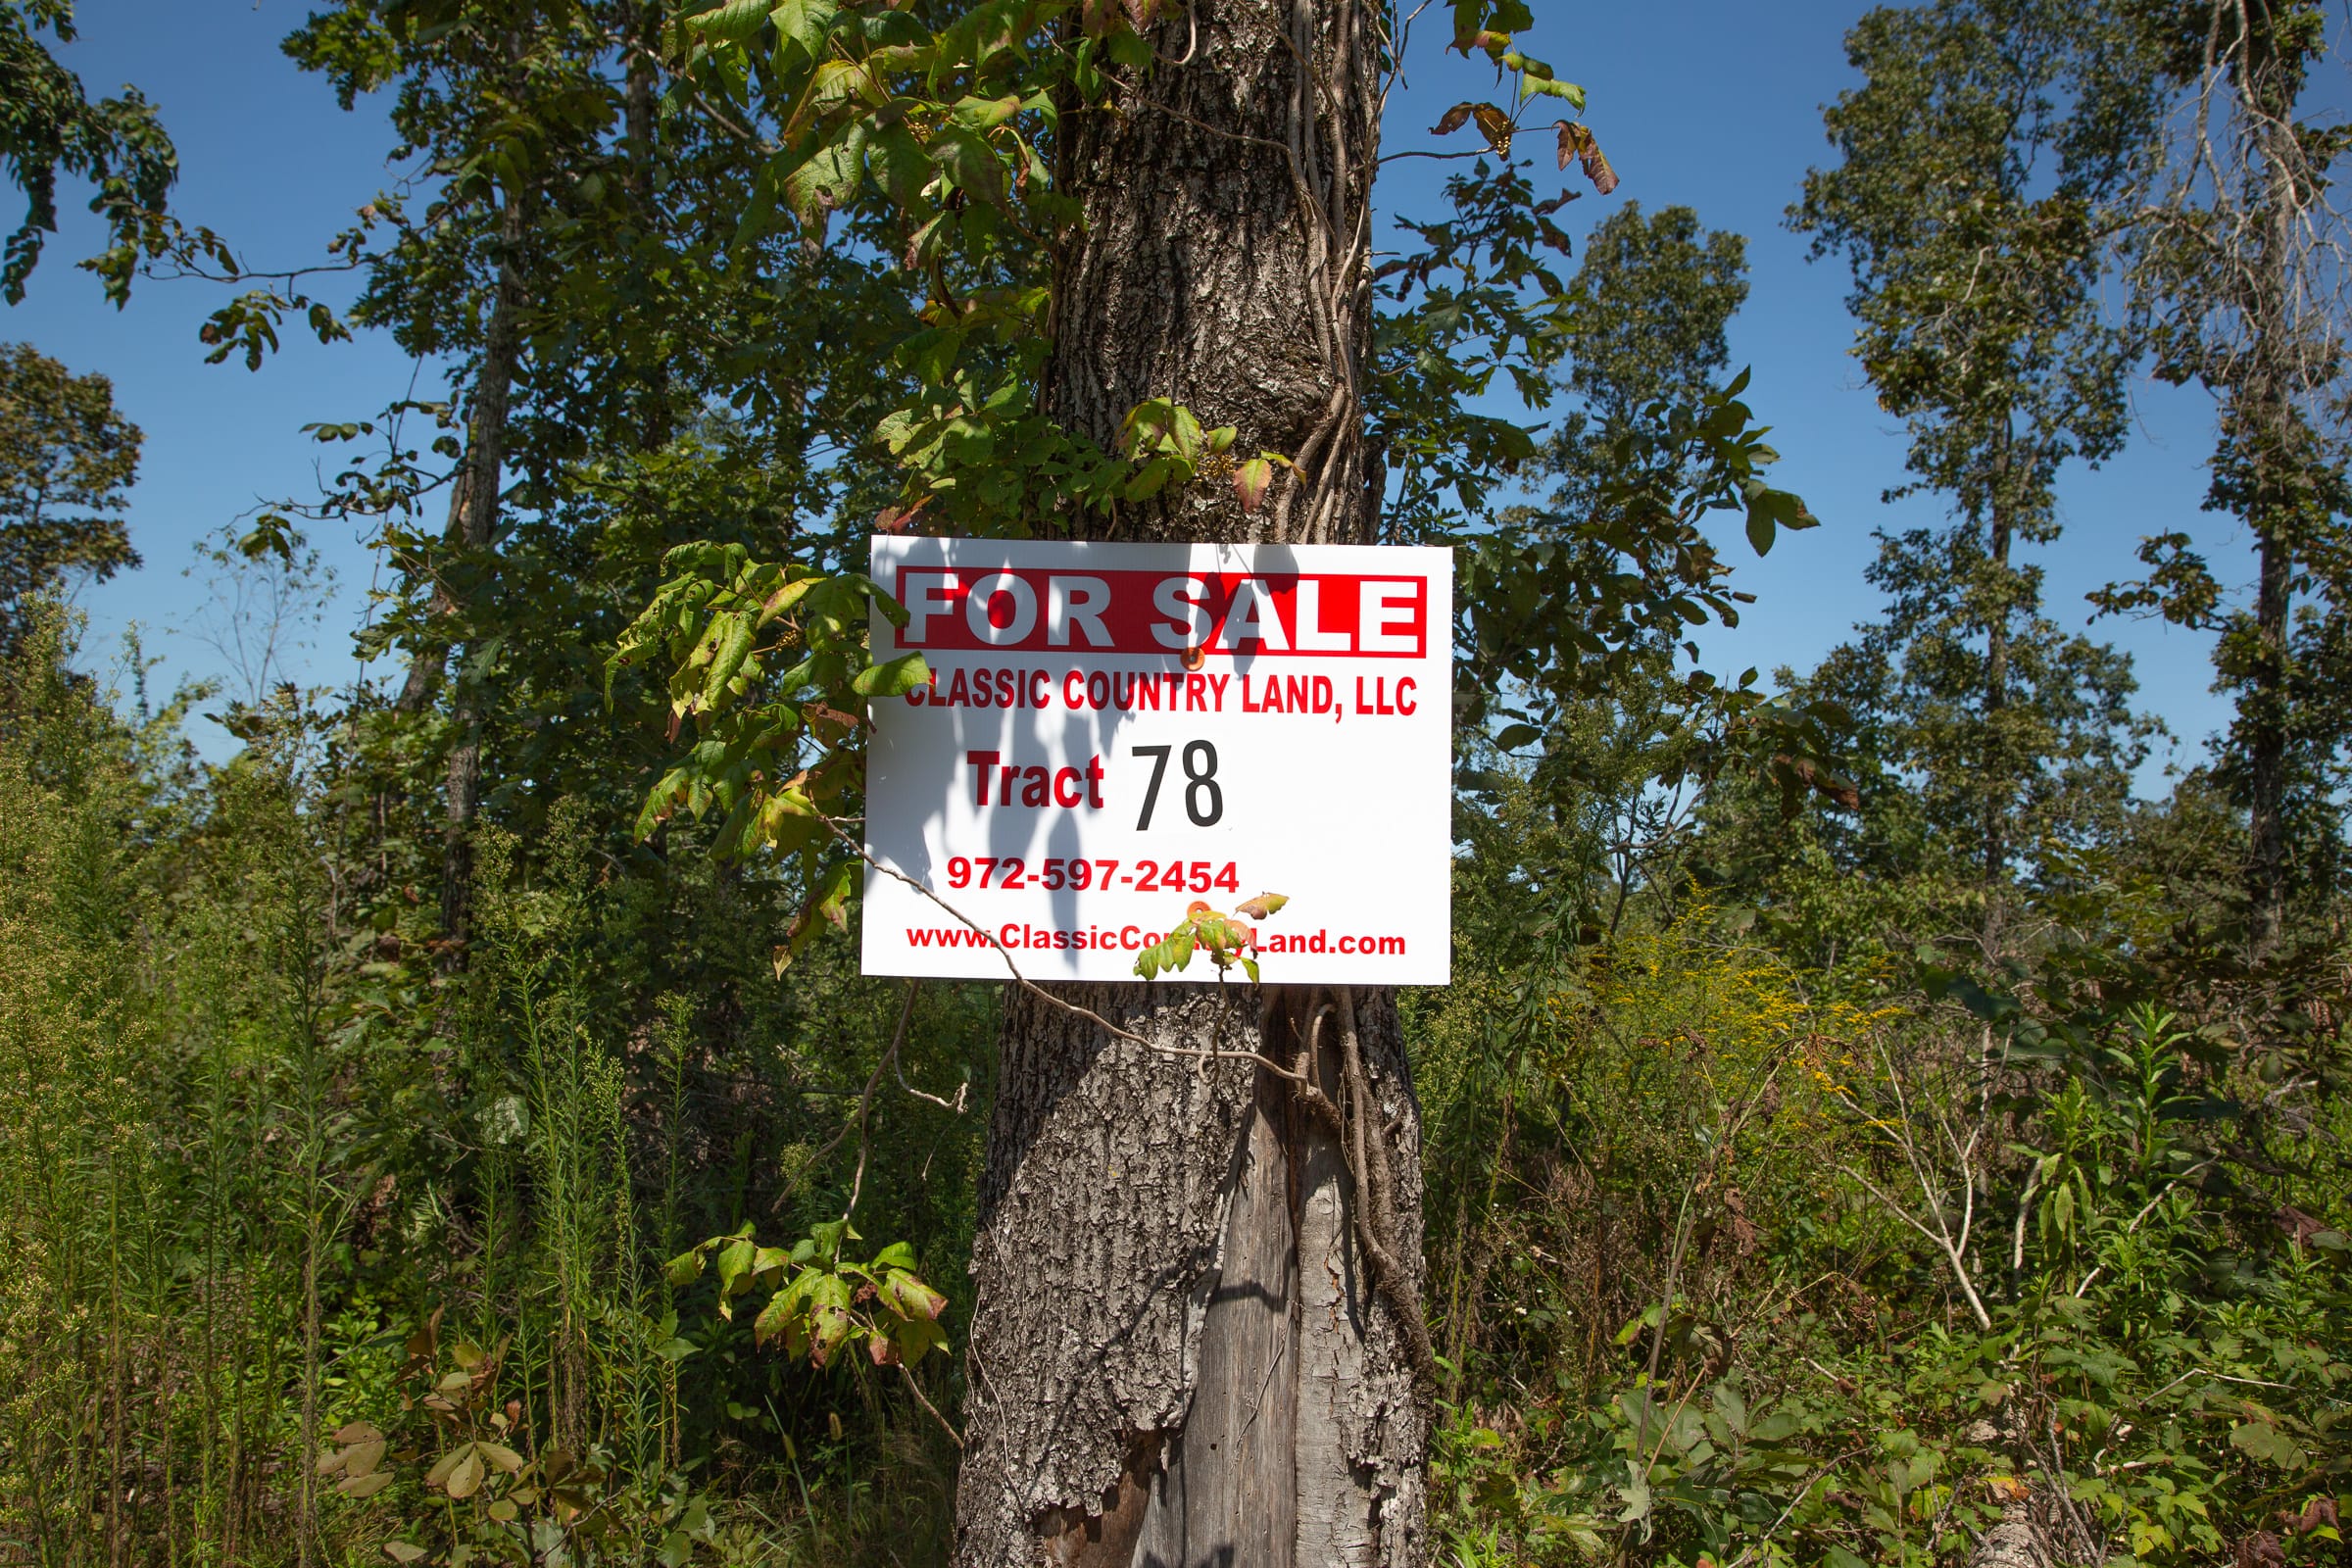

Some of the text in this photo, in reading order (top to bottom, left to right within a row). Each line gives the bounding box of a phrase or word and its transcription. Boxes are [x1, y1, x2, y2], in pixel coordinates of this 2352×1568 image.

[904, 572, 1419, 653] FOR SALE
[1062, 669, 1231, 712] COUNTRY
[1242, 674, 1343, 723] LAND,
[1355, 676, 1418, 716] LLC
[967, 740, 1224, 831] Tract 78
[947, 857, 1240, 894] 972-597-2454
[906, 922, 1406, 957] www.ClassicCoLand.com
